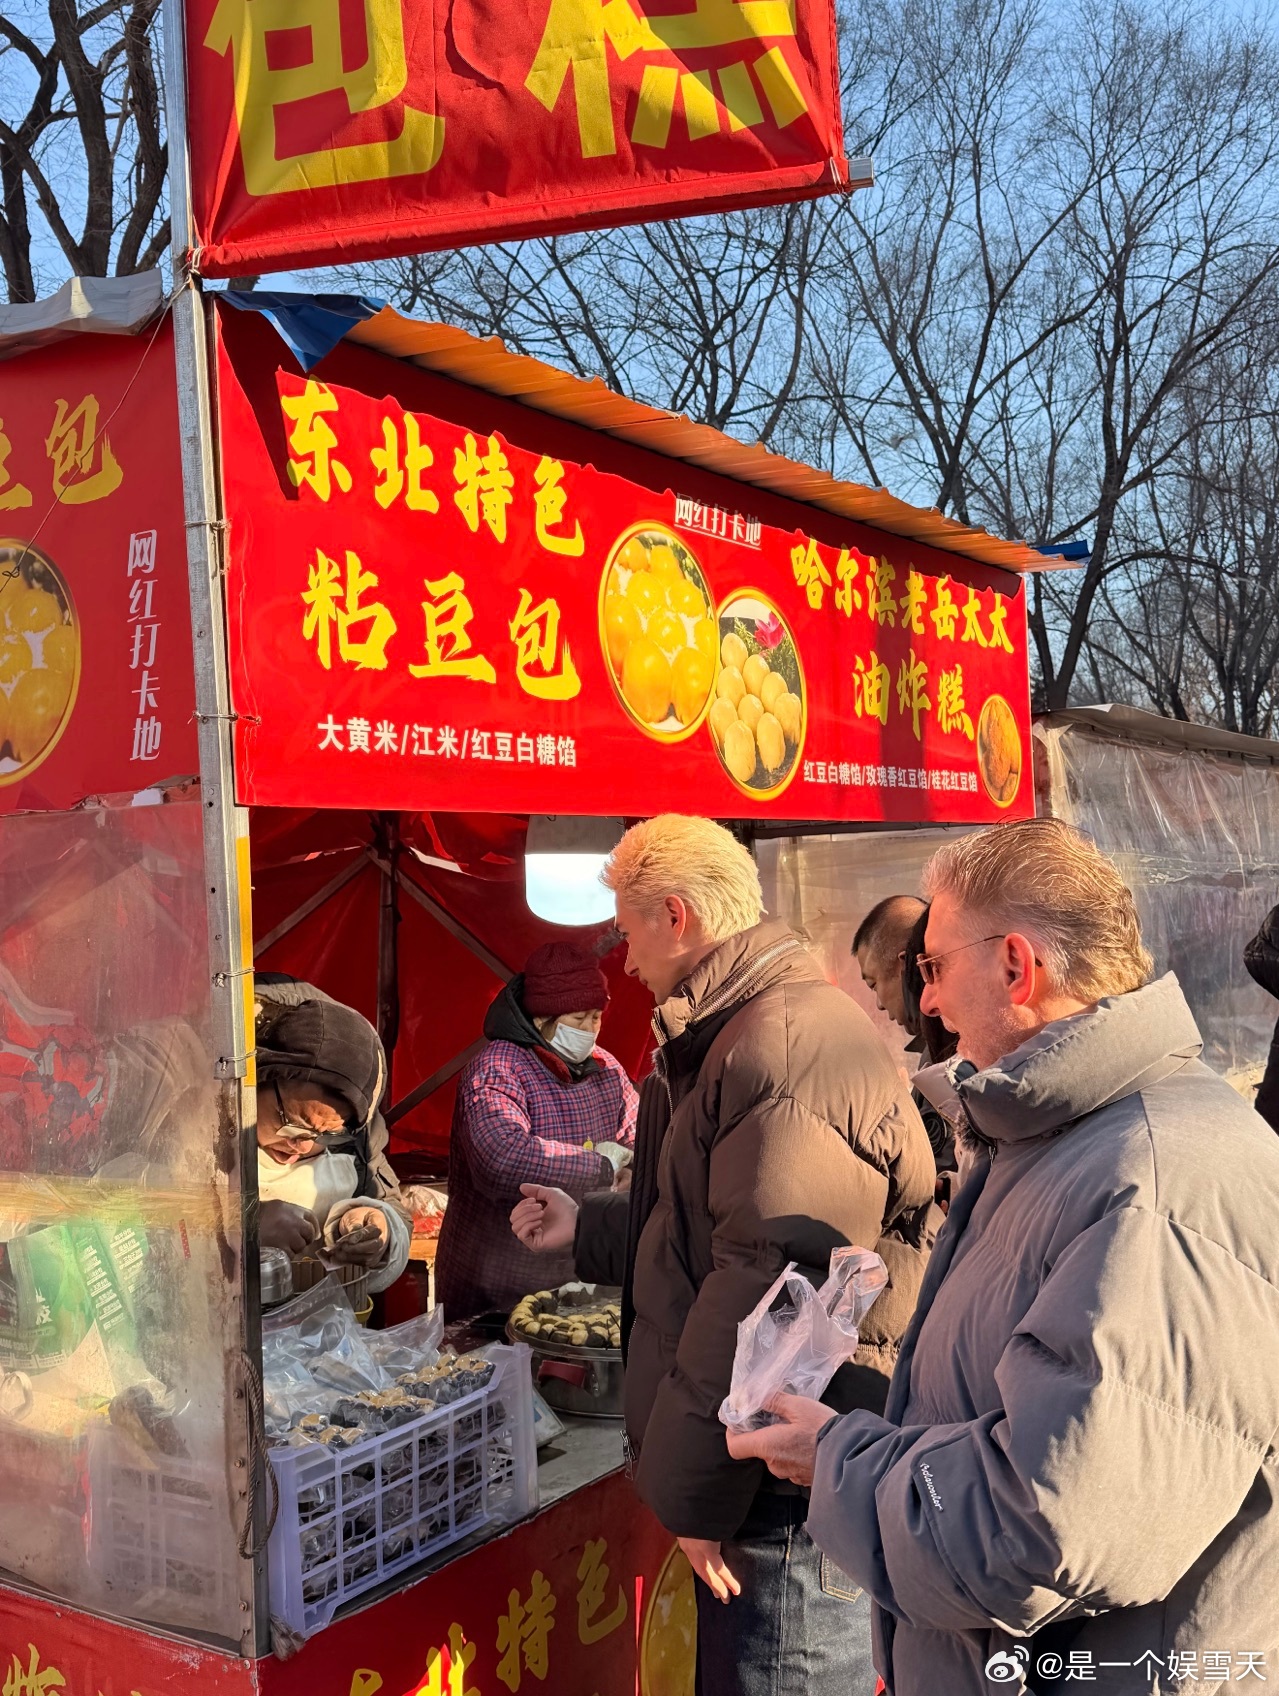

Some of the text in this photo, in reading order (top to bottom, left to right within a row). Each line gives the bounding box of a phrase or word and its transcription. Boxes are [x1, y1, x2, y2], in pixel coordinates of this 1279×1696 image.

[281, 374, 585, 556] 东北特色
[674, 492, 762, 547] 网红打卡地
[127, 528, 163, 762] 网红打卡地
[301, 548, 582, 701] 粘豆包
[790, 534, 1015, 654] 哈尔滨老岳太太
[317, 714, 578, 768] 大黄米/江米/红豆白糖馅
[852, 647, 975, 742] 油炸糕
[803, 759, 978, 793] 红豆白糖馅/玫瑰香红豆馅/桂花红豆馅
